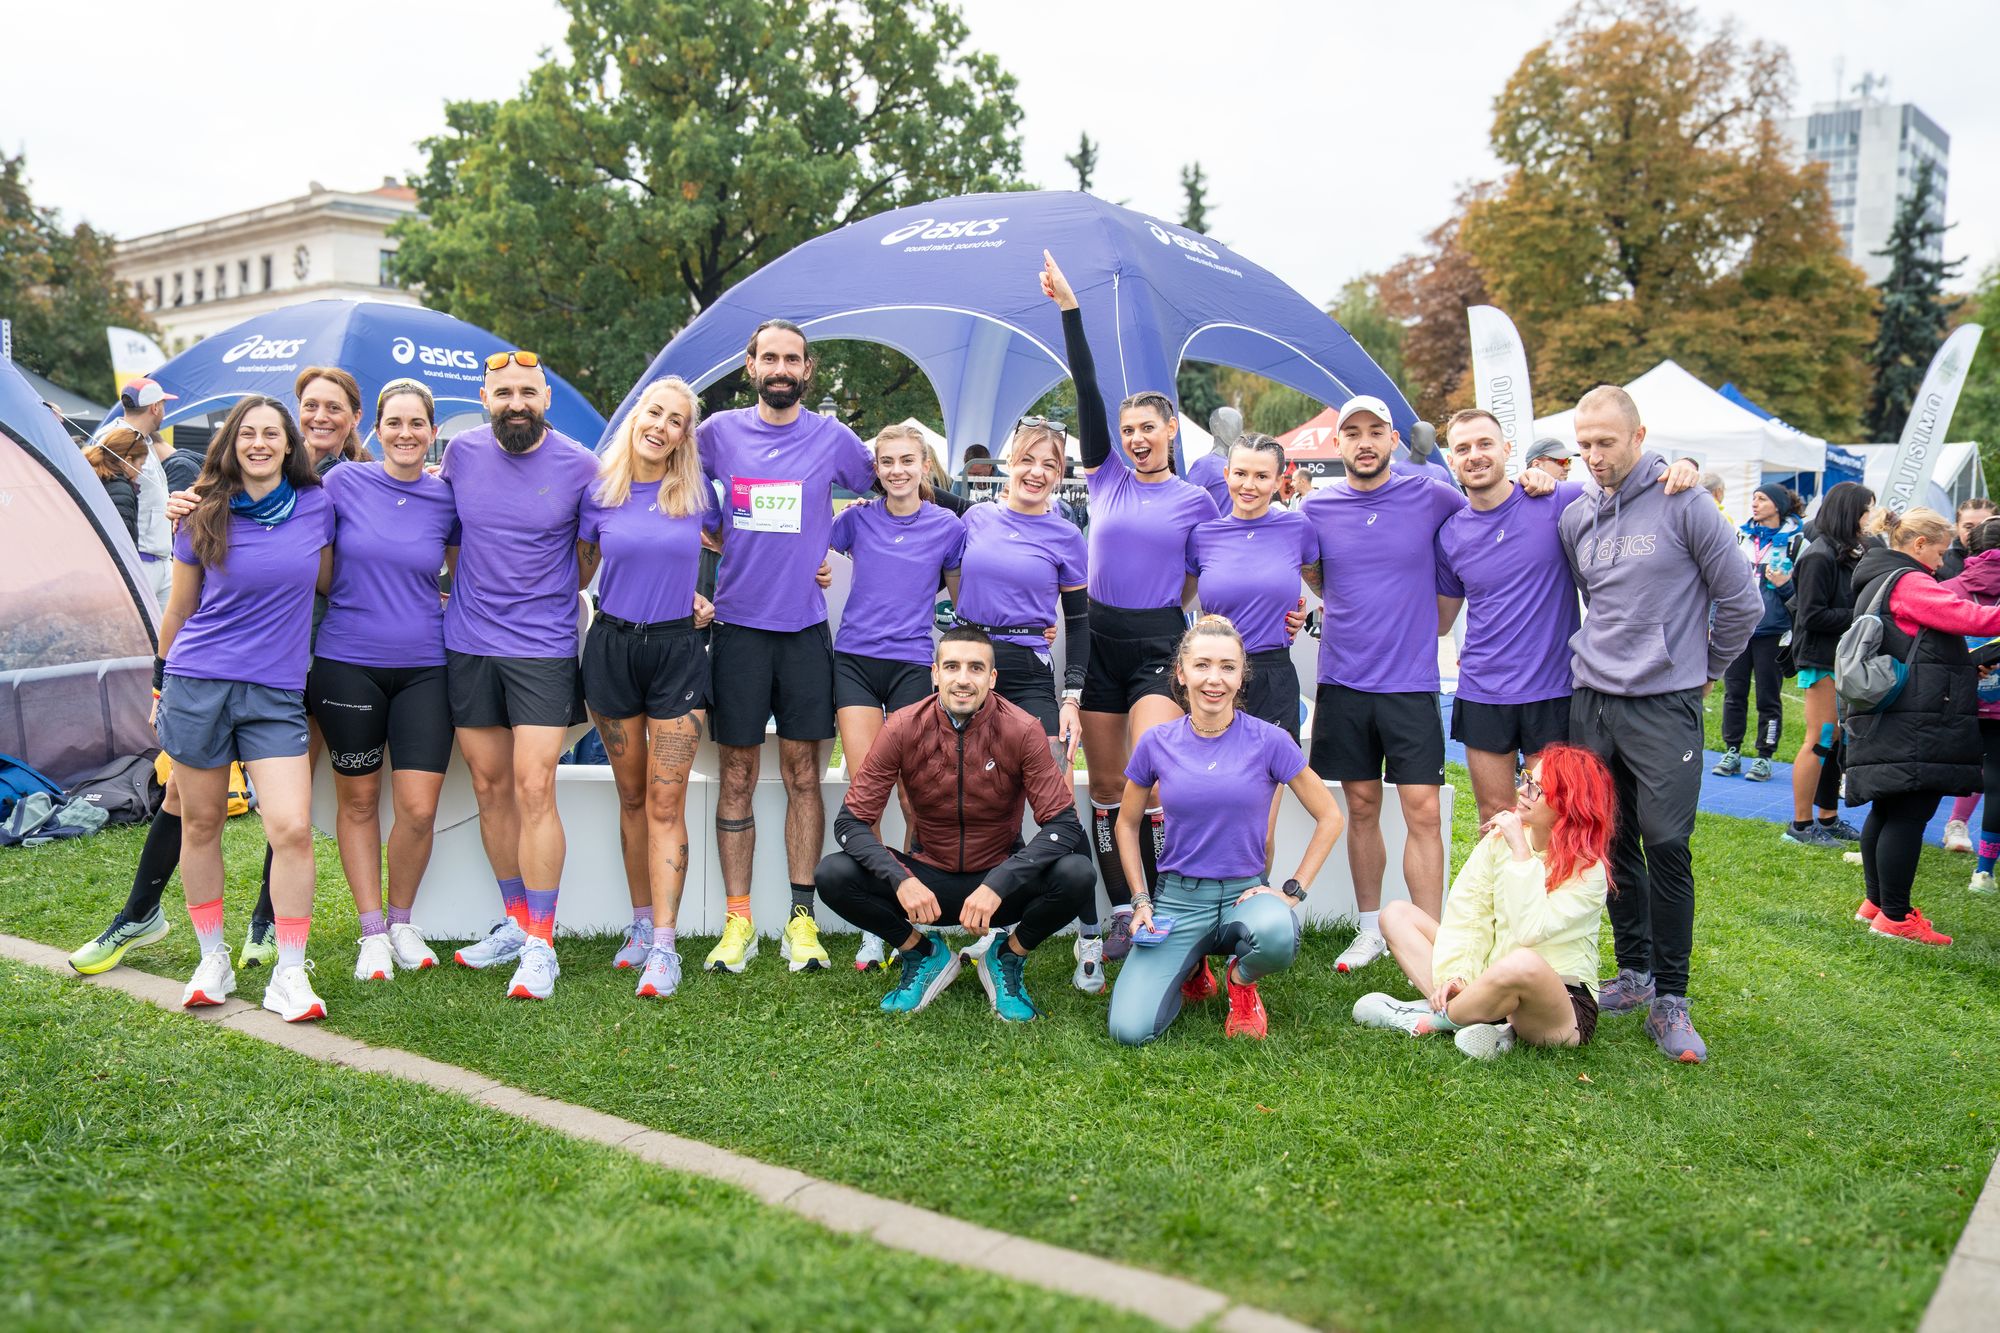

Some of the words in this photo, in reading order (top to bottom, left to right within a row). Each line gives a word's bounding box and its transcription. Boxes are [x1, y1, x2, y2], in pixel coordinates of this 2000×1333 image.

[920, 217, 1009, 240] asics
[419, 345, 479, 370] asics
[754, 495, 798, 511] 6377
[1103, 826, 1113, 852] SPORT
